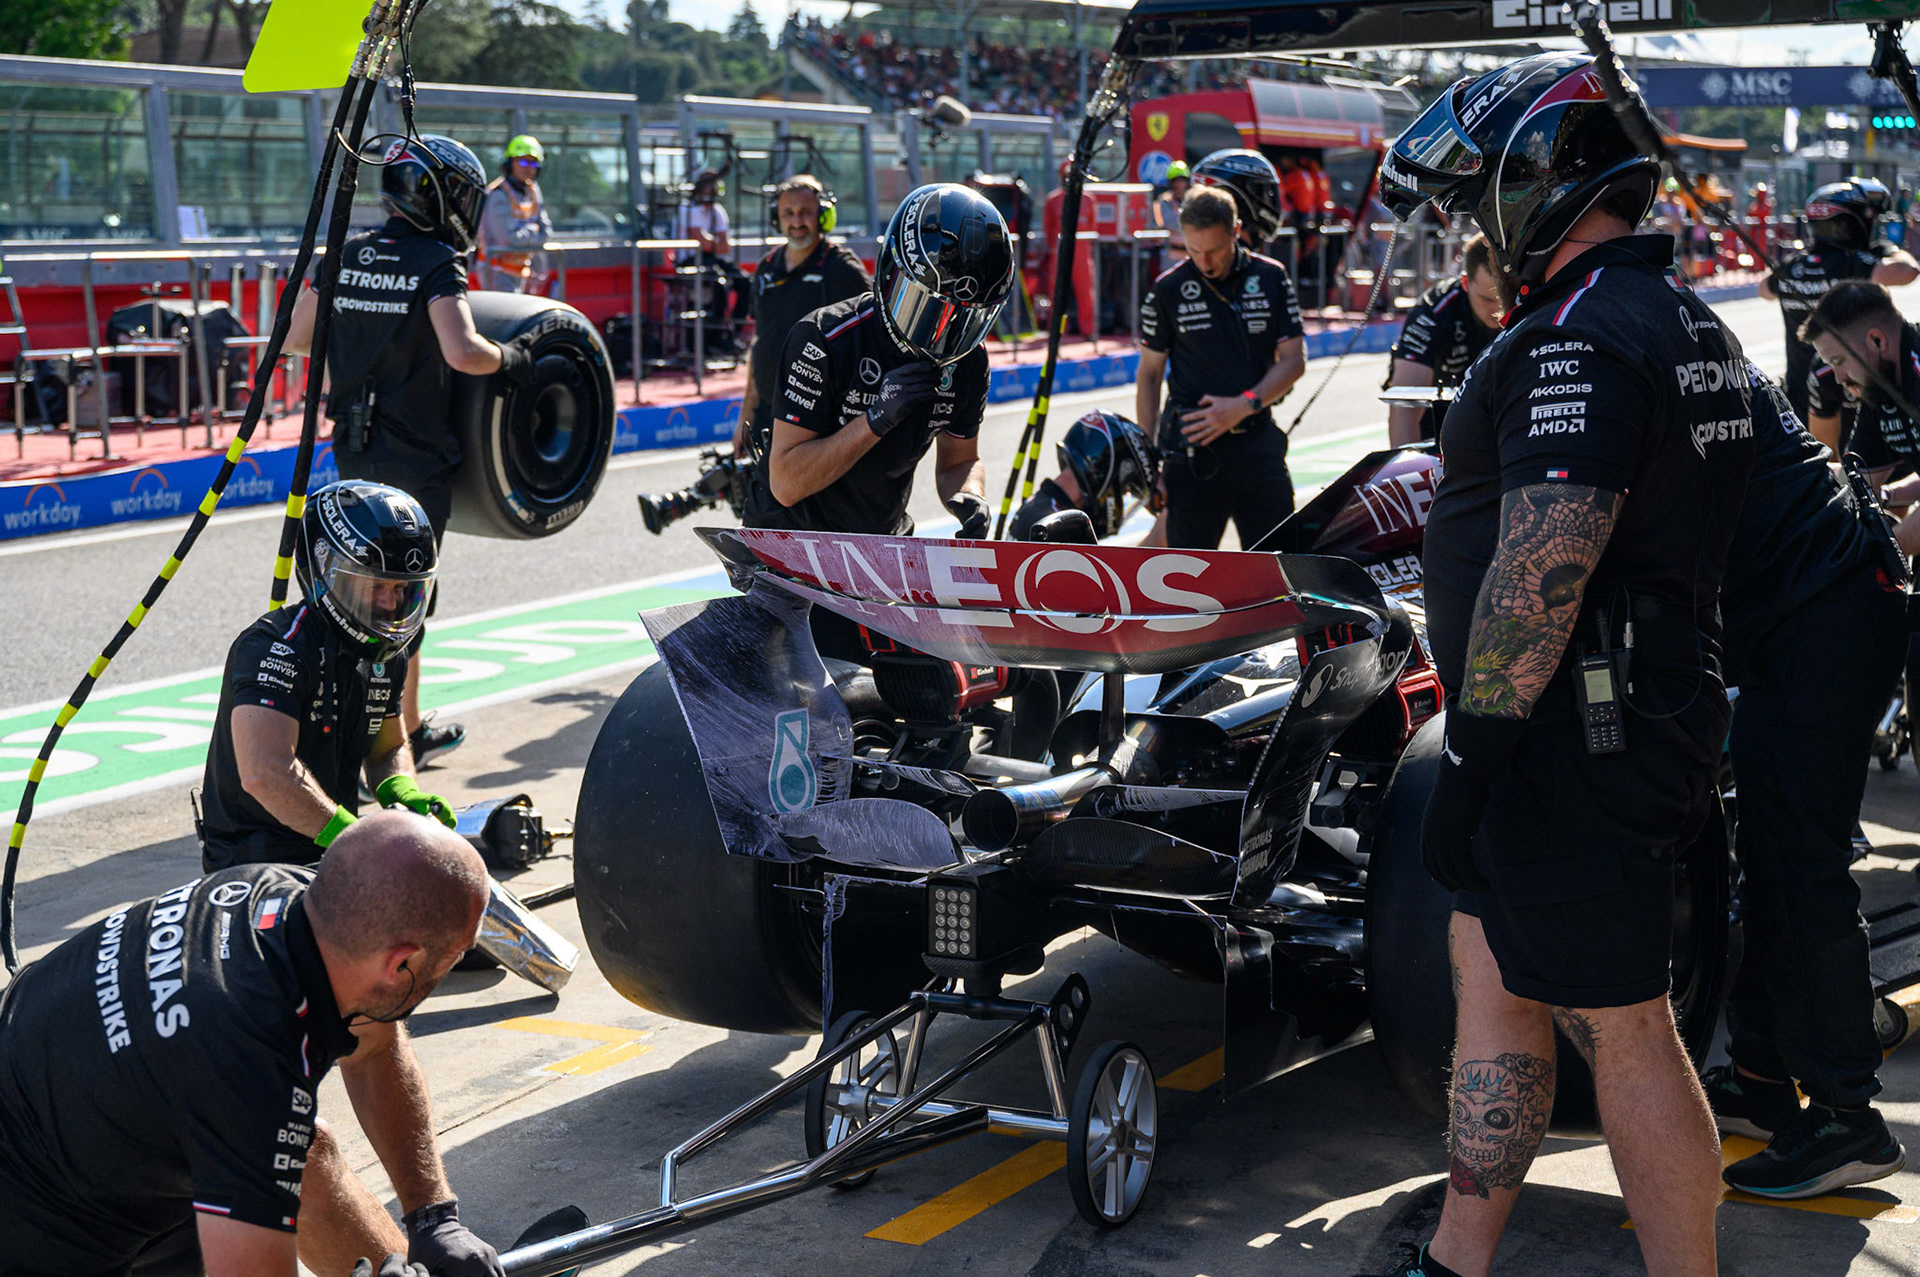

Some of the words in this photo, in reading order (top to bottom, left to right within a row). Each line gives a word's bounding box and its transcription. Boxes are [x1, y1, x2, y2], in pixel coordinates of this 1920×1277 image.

[1730, 71, 1793, 96] MSC
[903, 203, 920, 266] SOLERA
[338, 268, 419, 291] ETRONAS
[336, 296, 409, 314] CROWDSTRIKE
[1539, 341, 1594, 356] SOLERA
[1539, 360, 1580, 379] IWC
[784, 388, 817, 411] nuvei
[796, 381, 822, 397] Einhell
[1530, 401, 1587, 421] PIRELLI
[1528, 420, 1568, 438] AMD
[224, 475, 275, 501] orkday
[111, 489, 182, 516] workday
[4, 500, 82, 531] workday
[323, 500, 358, 551] SOLERA
[1362, 554, 1423, 587] OLER
[802, 538, 1227, 635] INEOS
[321, 594, 369, 644] Einhell
[259, 659, 299, 679] BONVOY
[268, 676, 294, 690] Einhell
[367, 689, 391, 701] INEOS
[148, 878, 202, 1039] TRONAS
[95, 903, 134, 1054] OWDSTRIKE
